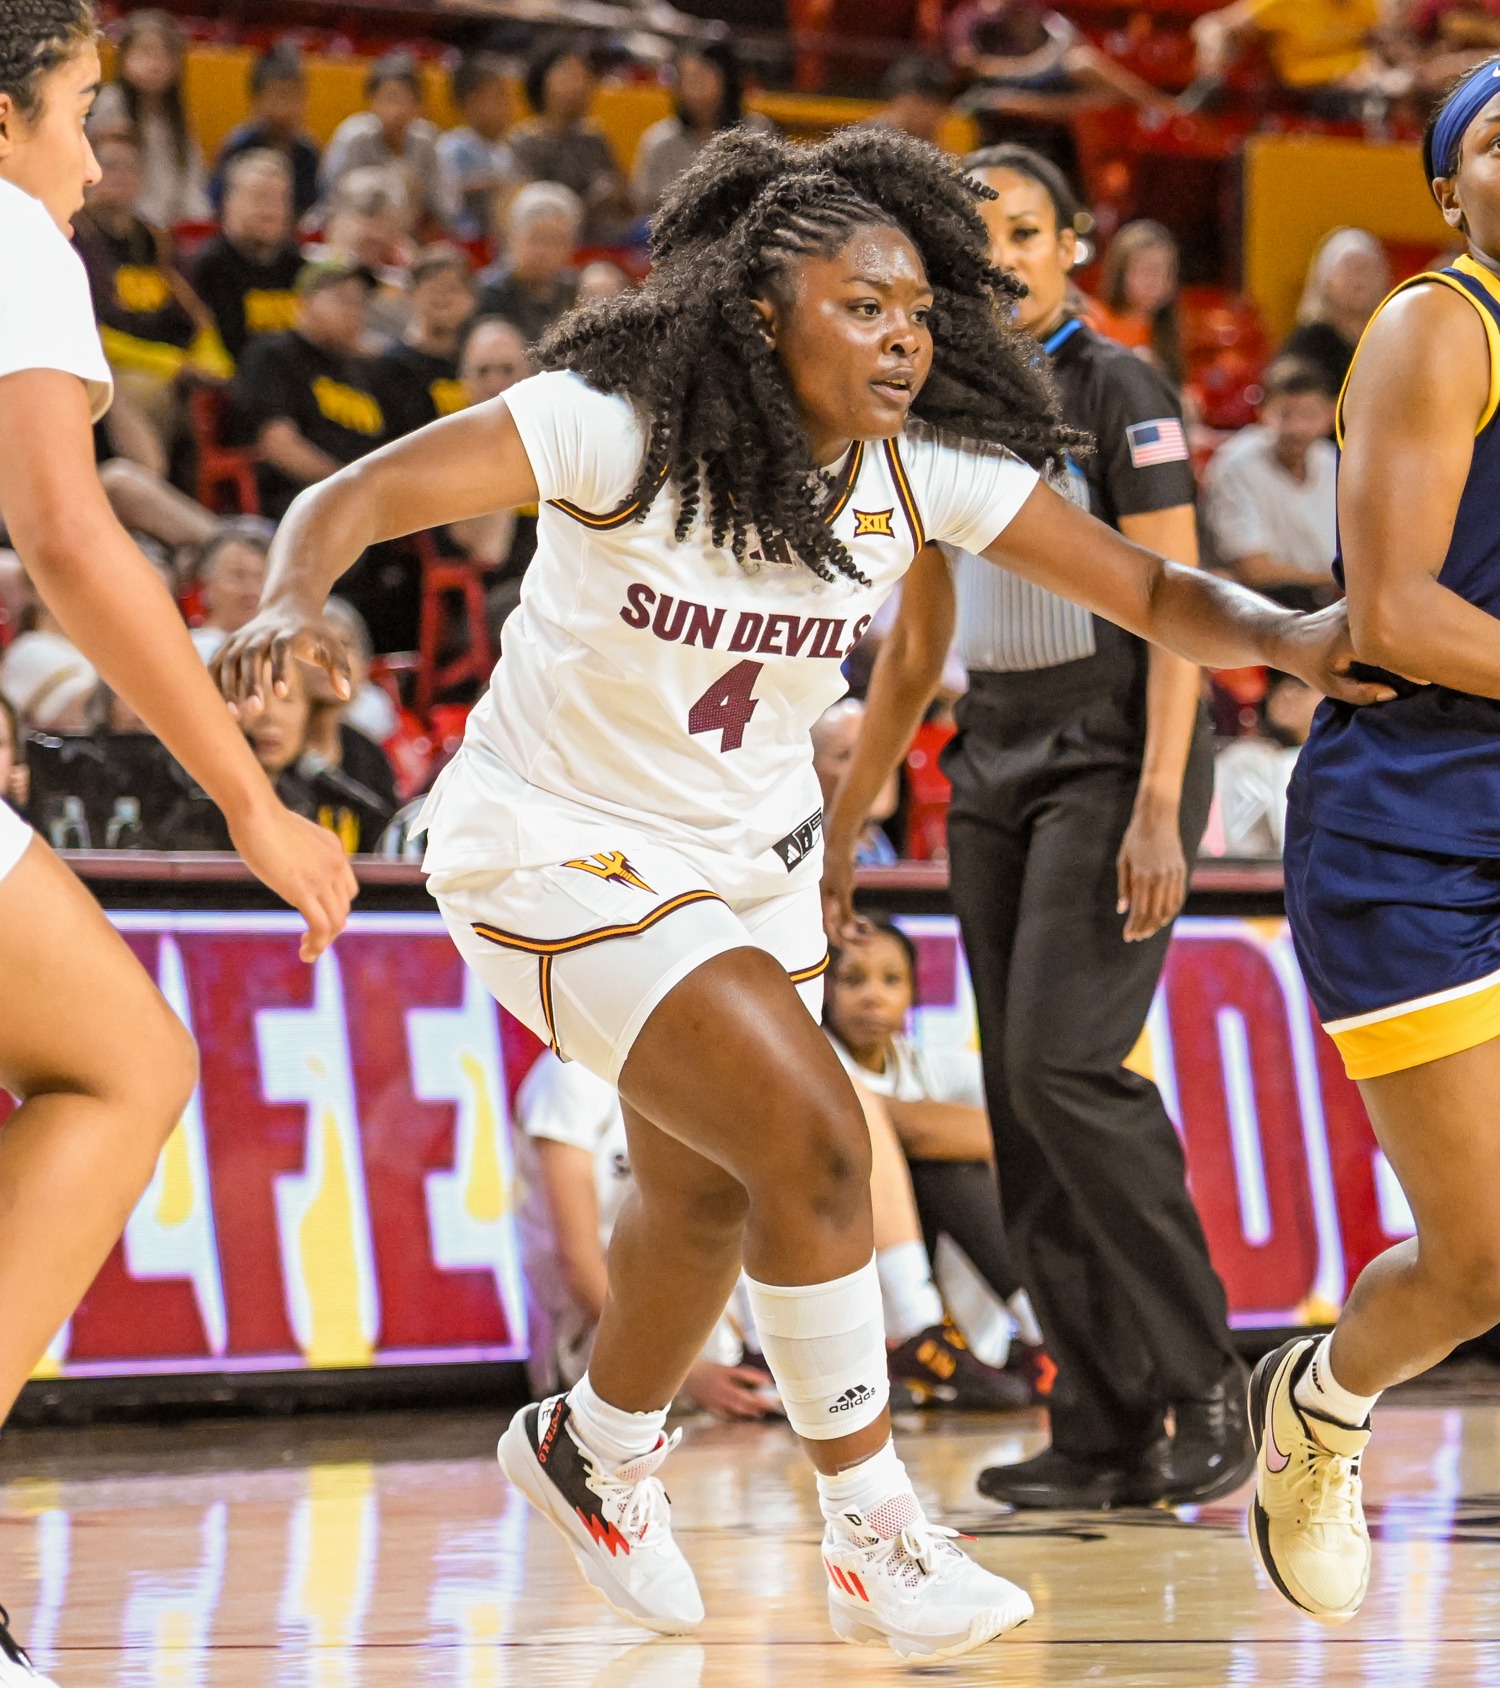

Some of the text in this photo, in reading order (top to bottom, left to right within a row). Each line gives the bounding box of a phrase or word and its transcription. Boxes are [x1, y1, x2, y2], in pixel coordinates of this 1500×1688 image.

[856, 511, 892, 534] XII
[619, 583, 872, 659] SUN DEVILS
[688, 659, 764, 753] 4
[829, 1387, 876, 1414] adidas
